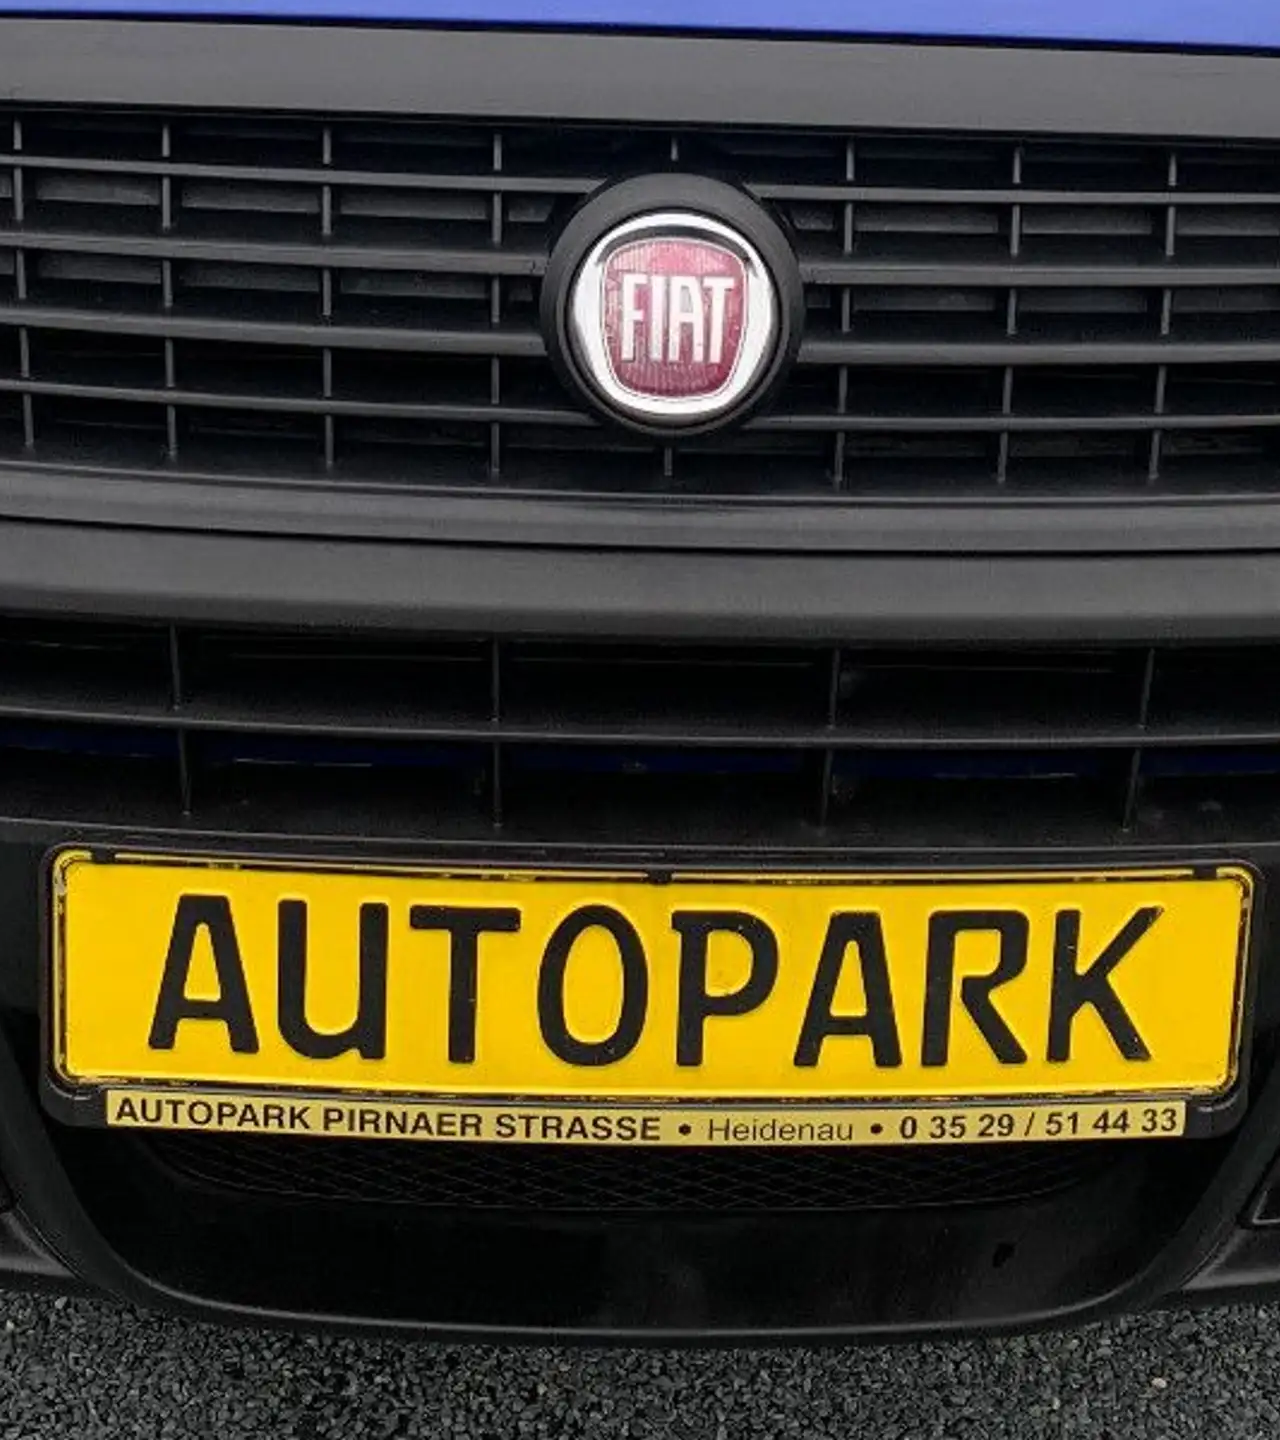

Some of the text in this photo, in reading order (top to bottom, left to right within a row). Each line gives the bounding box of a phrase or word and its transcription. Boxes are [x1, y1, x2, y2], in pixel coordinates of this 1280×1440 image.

[620, 272, 736, 364] FIAT
[147, 893, 1167, 1067] AUTOPARK
[115, 1096, 312, 1131] AUTOPARK
[321, 1107, 483, 1138] PIRNAER
[494, 1114, 662, 1142] STRASSE
[707, 1117, 855, 1143] Heidenau
[899, 1116, 918, 1140] 0
[928, 1116, 967, 1139] 35
[977, 1113, 1015, 1138] 29
[1044, 1112, 1080, 1135] 51
[1091, 1110, 1132, 1135] 44
[1140, 1107, 1179, 1133] 33
